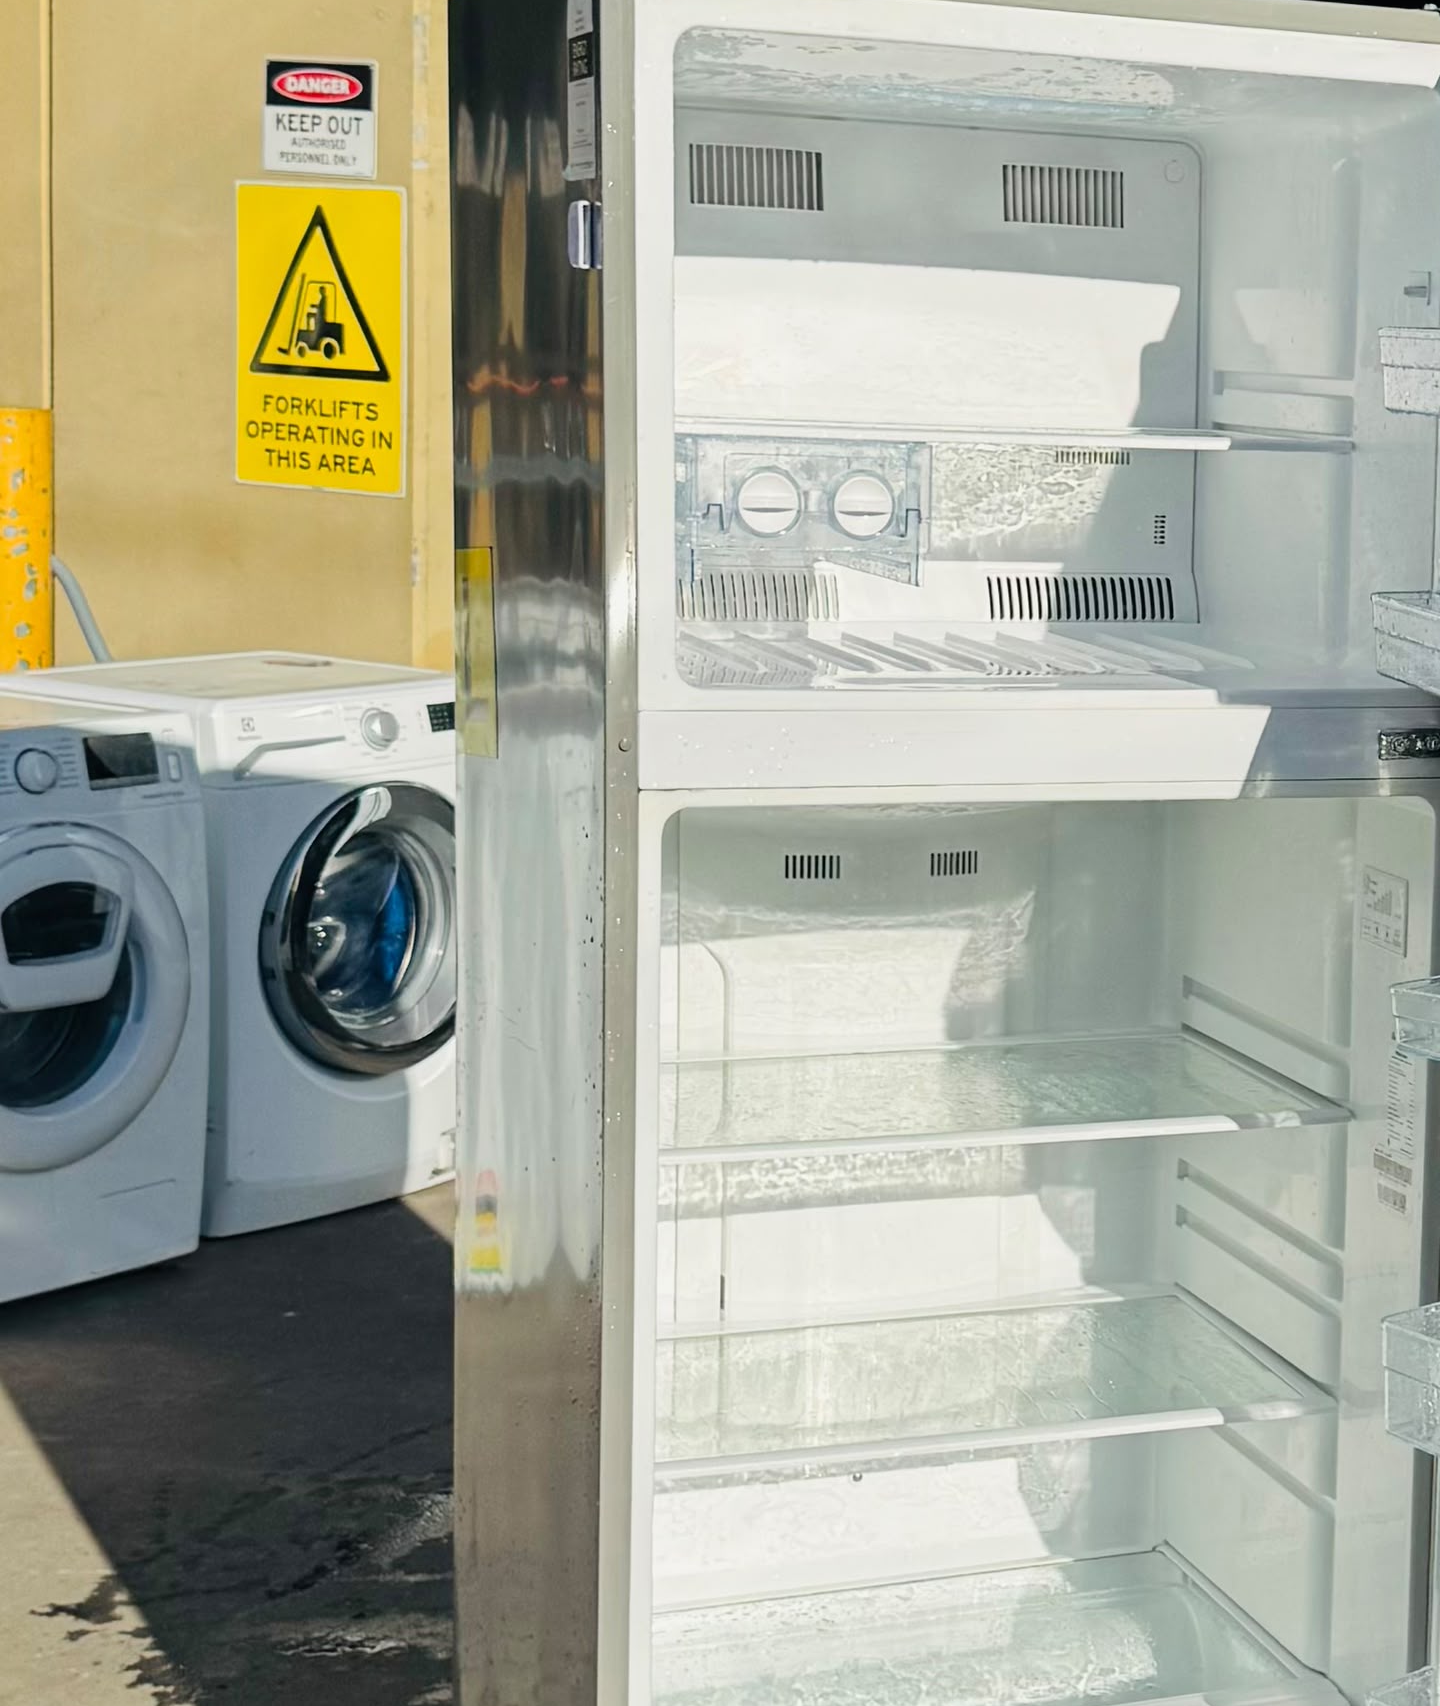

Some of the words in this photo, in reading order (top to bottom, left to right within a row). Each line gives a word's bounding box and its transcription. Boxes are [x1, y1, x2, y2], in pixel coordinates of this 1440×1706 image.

[284, 76, 350, 95] DANGER
[276, 112, 322, 133] KEEP
[328, 115, 363, 135] OUT
[291, 137, 346, 150] AUTHORISED
[279, 151, 329, 166] PERSONNEL
[334, 154, 357, 167] ONLY
[263, 394, 379, 422] FORKLIFTS
[246, 420, 365, 447] OPERATING
[372, 430, 393, 450] IN
[264, 448, 312, 470] THIS
[317, 453, 377, 476] AREA
